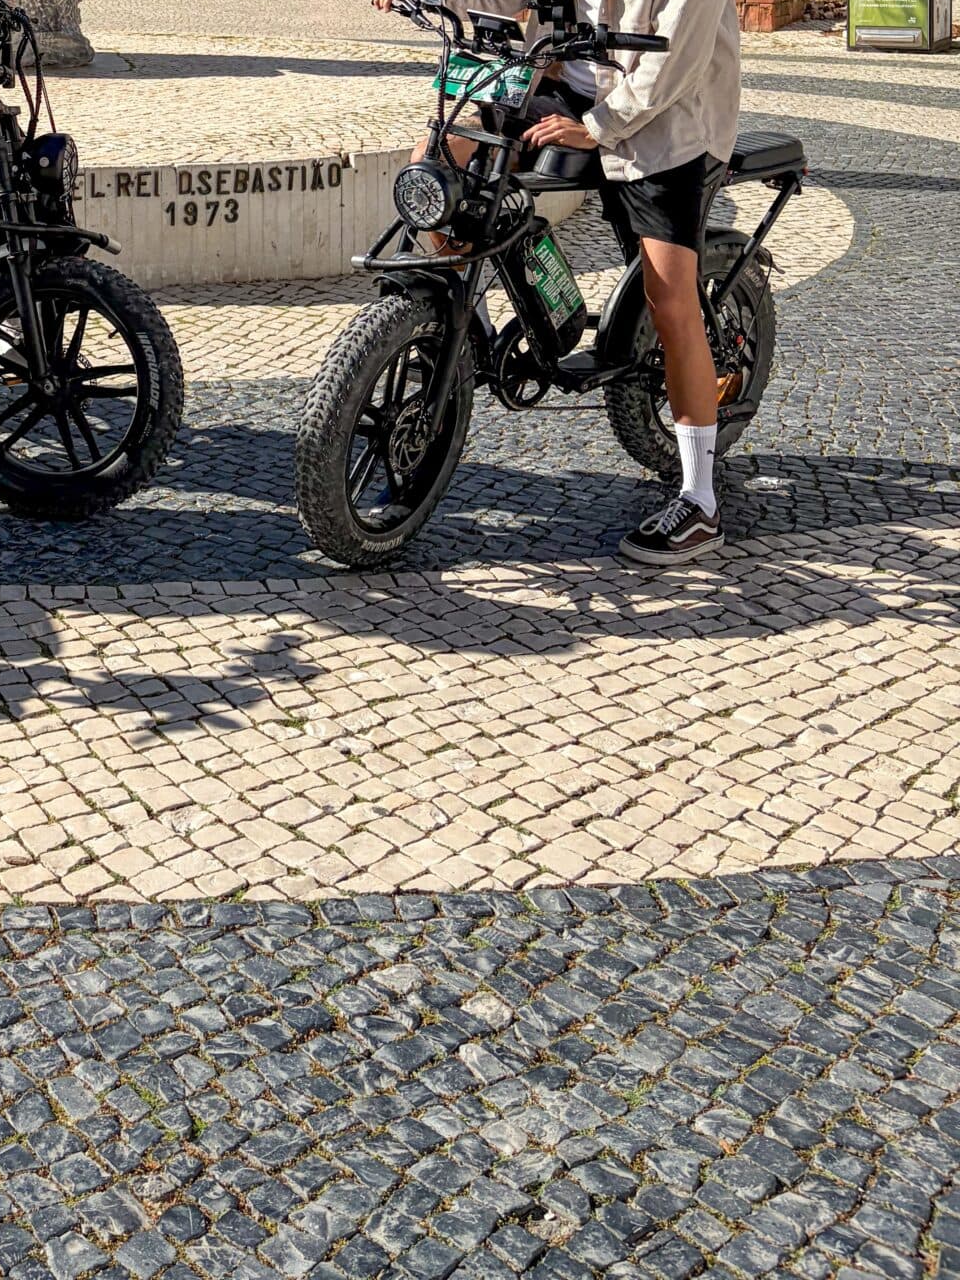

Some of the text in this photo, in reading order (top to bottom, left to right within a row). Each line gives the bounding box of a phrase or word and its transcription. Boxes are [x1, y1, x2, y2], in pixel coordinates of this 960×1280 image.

[164, 198, 240, 227] 1973
[536, 244, 563, 280] FATBIKE
[556, 273, 580, 307] RENTAL
[540, 277, 561, 305] TOURS
